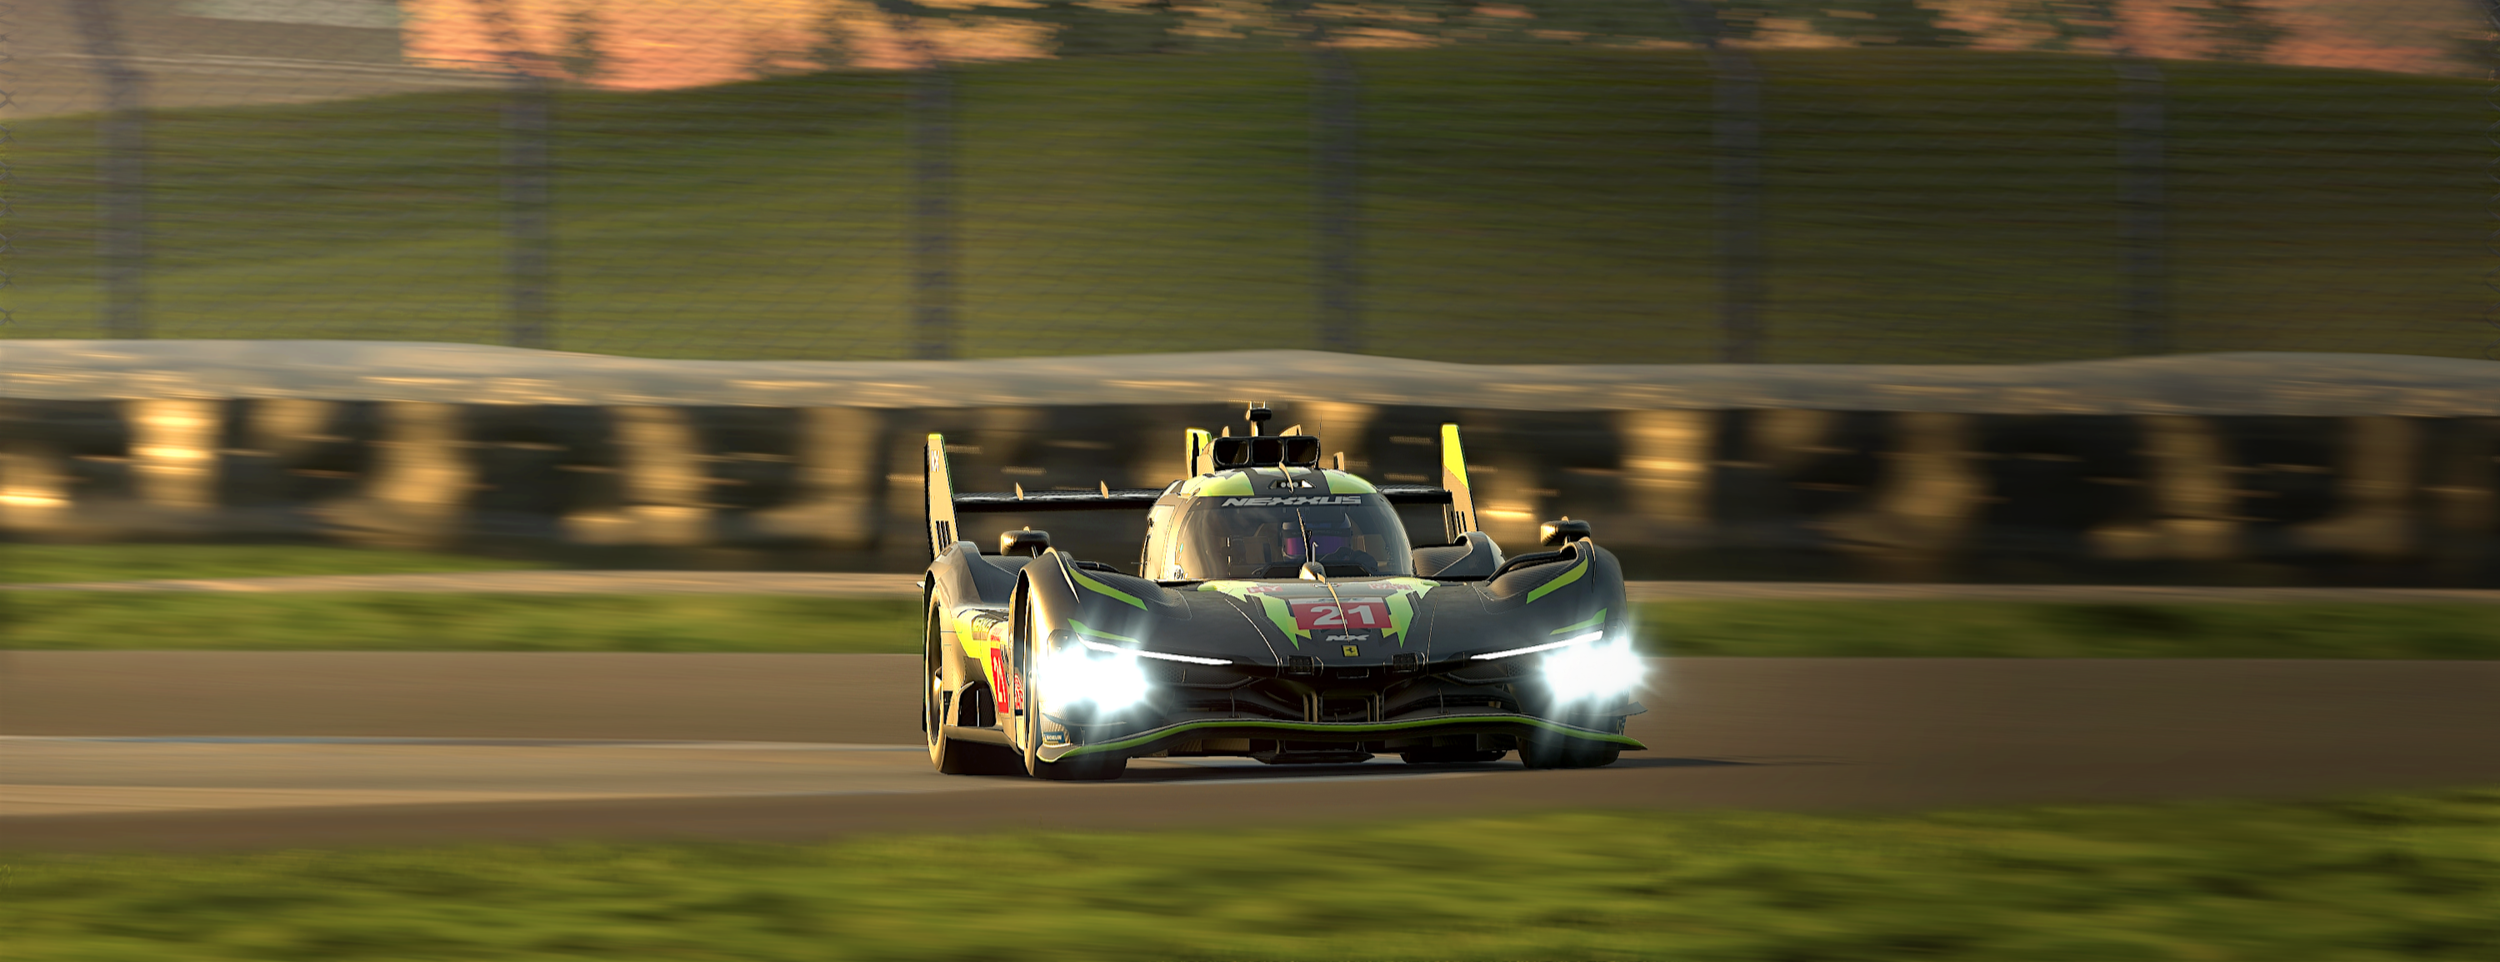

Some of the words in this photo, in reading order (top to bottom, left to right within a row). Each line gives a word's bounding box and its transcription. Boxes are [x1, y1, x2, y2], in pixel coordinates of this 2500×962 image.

[1221, 495, 1361, 507] NEXXUS
[1310, 604, 1375, 626] 21
[1325, 634, 1370, 642] NX
[992, 656, 1007, 703] 21
